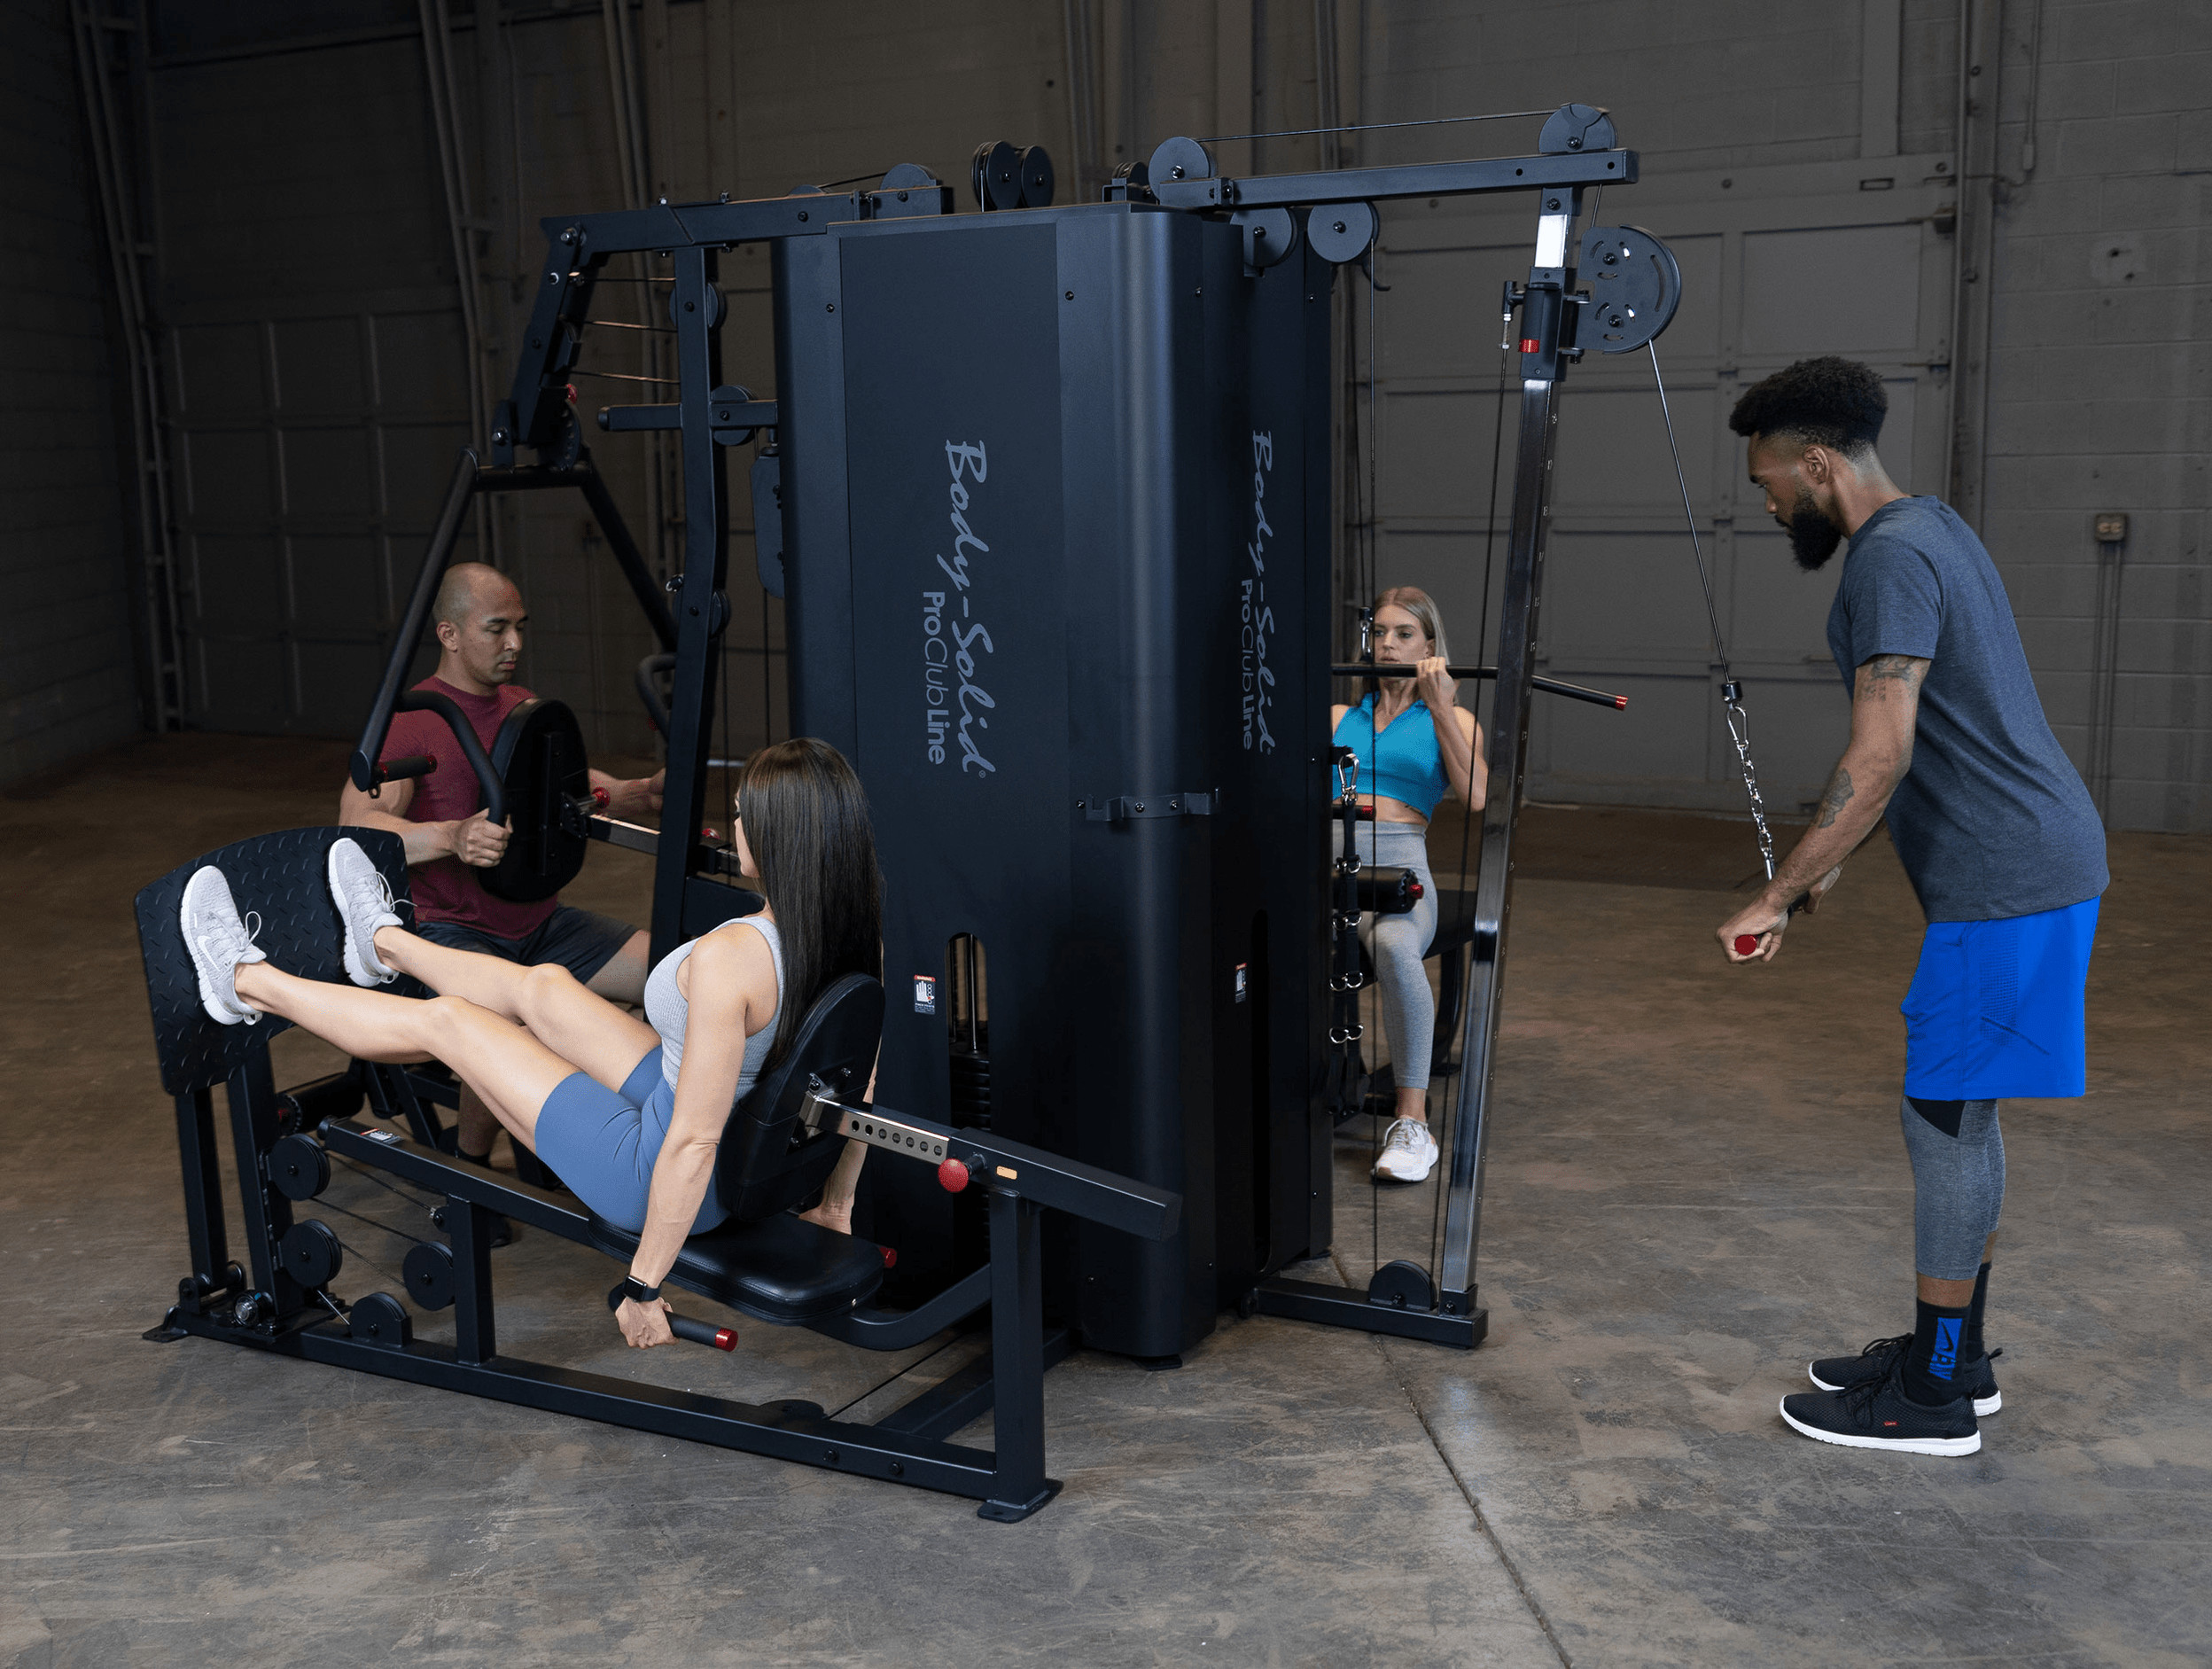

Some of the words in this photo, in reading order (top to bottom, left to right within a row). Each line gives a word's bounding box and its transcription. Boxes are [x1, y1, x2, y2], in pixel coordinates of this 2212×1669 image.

[923, 591, 950, 765] ProClubLine
[937, 439, 995, 774] Body-Solid
[1249, 429, 1275, 753] Body-Solid
